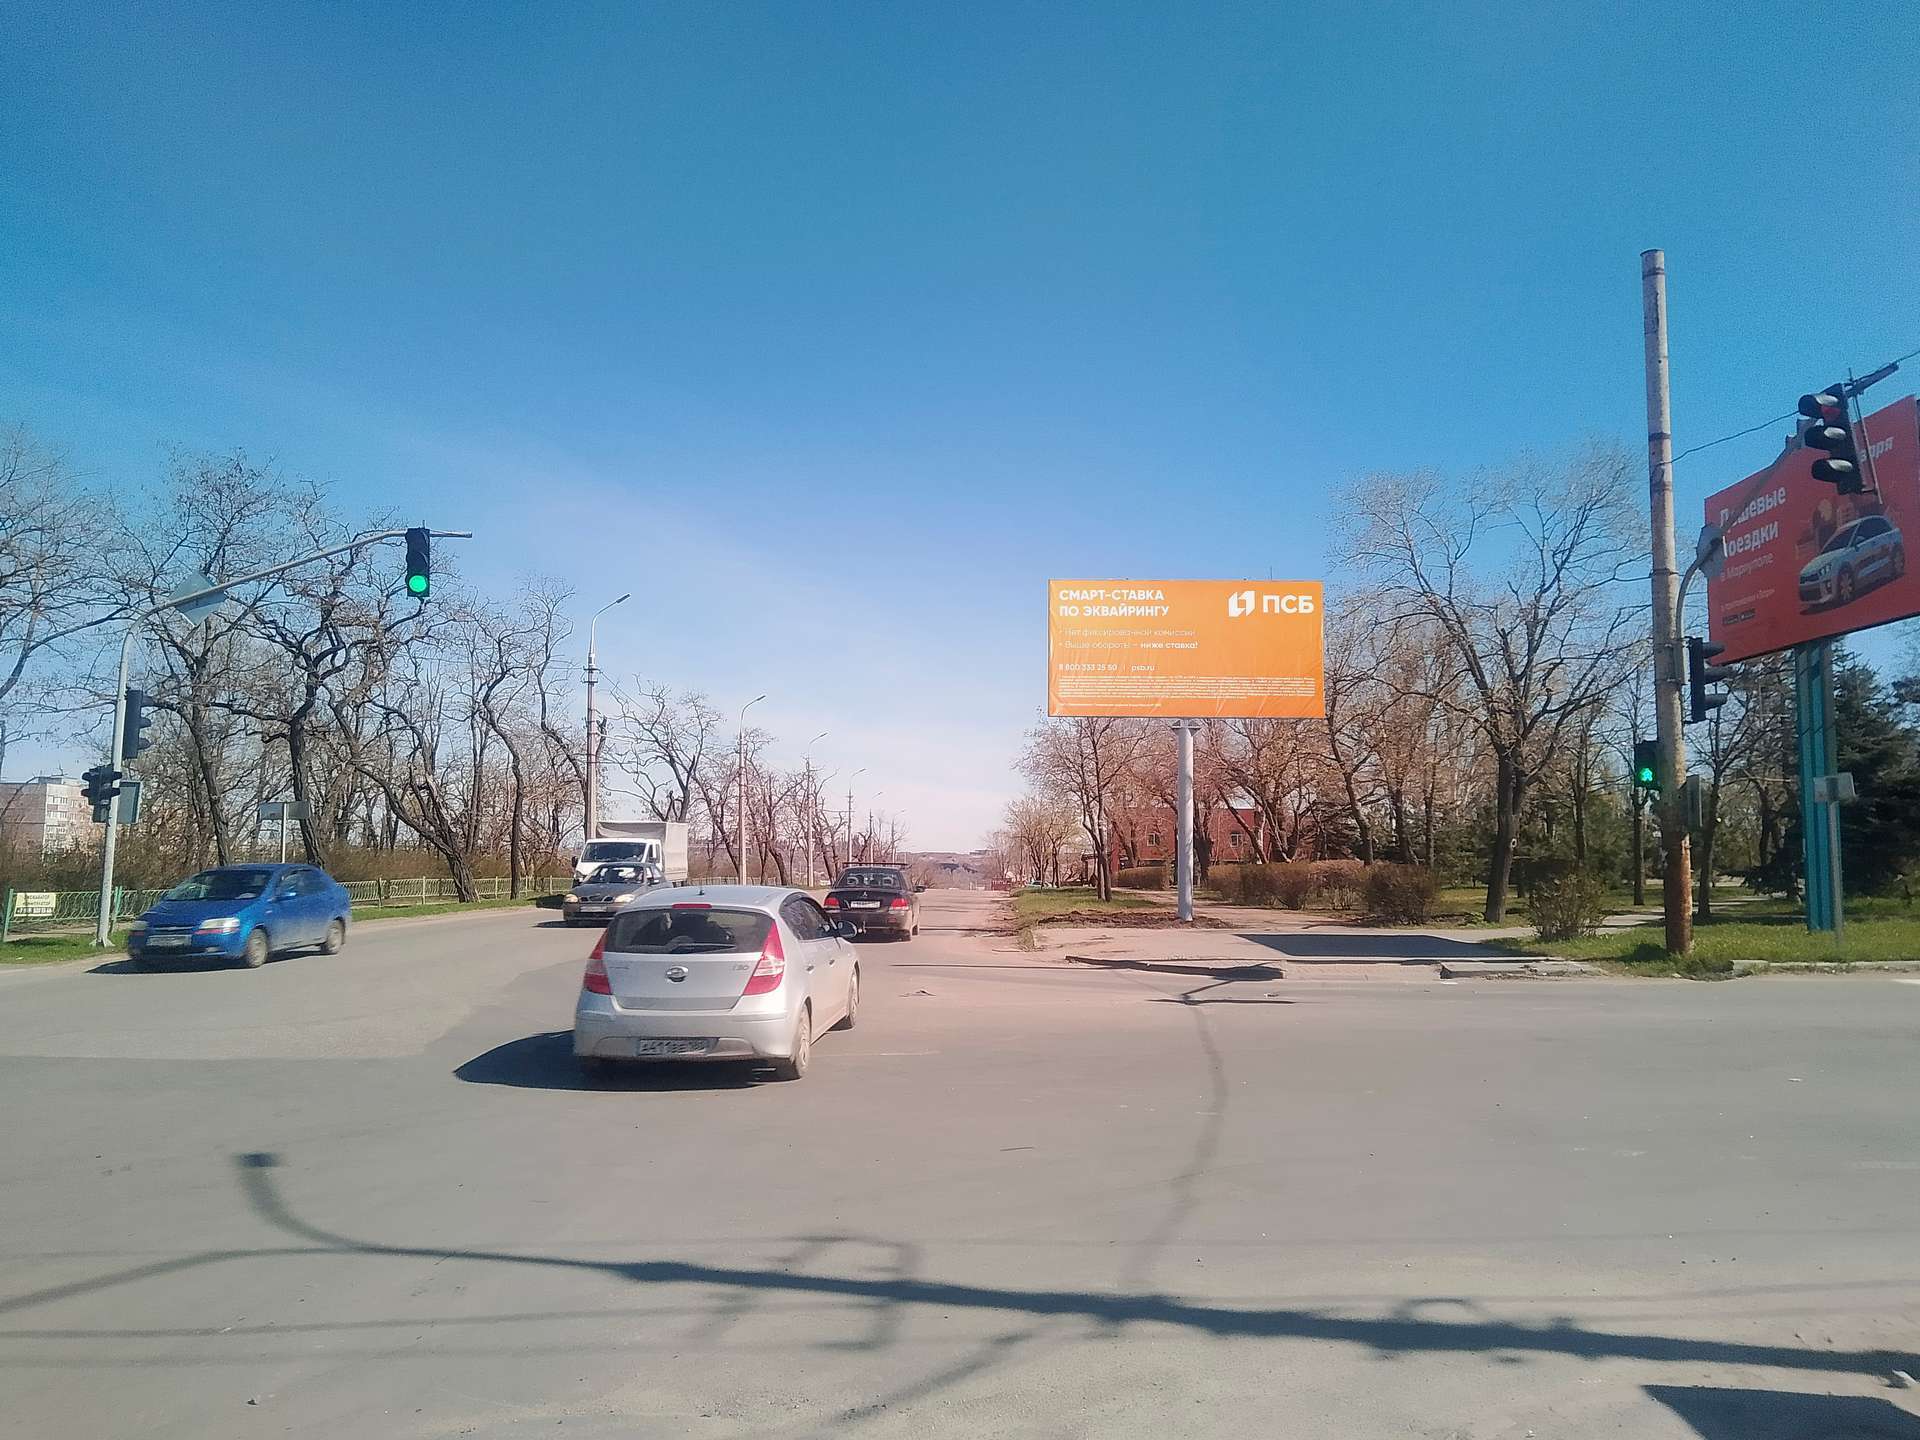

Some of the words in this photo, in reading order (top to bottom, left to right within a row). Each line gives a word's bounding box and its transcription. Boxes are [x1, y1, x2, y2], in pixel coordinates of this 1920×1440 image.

[1059, 589, 1165, 601] СМАРТ-СТАВКА
[1059, 605, 1080, 617] ПО
[1083, 602, 1169, 617] ЭКВАЙРИНГУ
[1263, 594, 1315, 614] ПСБ
